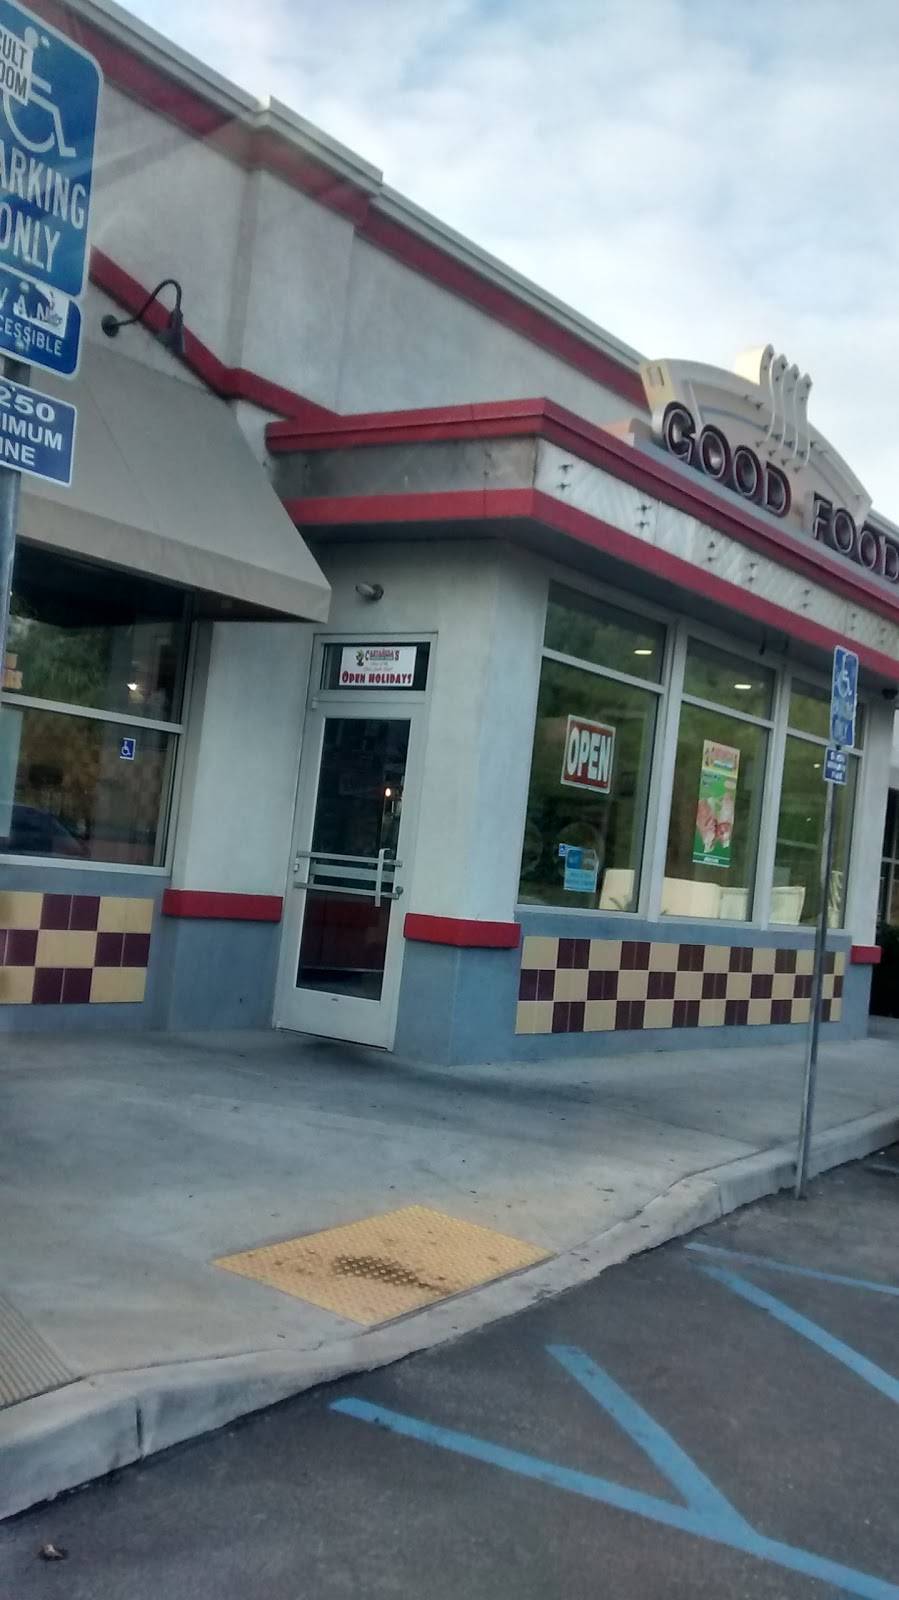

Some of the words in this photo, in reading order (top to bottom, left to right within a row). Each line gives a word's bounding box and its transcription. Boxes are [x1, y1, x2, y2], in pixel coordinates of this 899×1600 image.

[0, 201, 61, 273] ONLY
[663, 401, 791, 518] GOOD
[812, 492, 899, 582] FOOD
[342, 670, 366, 683] OPEN
[368, 672, 412, 684] HOLIDAYS
[567, 727, 612, 782] OPEN
